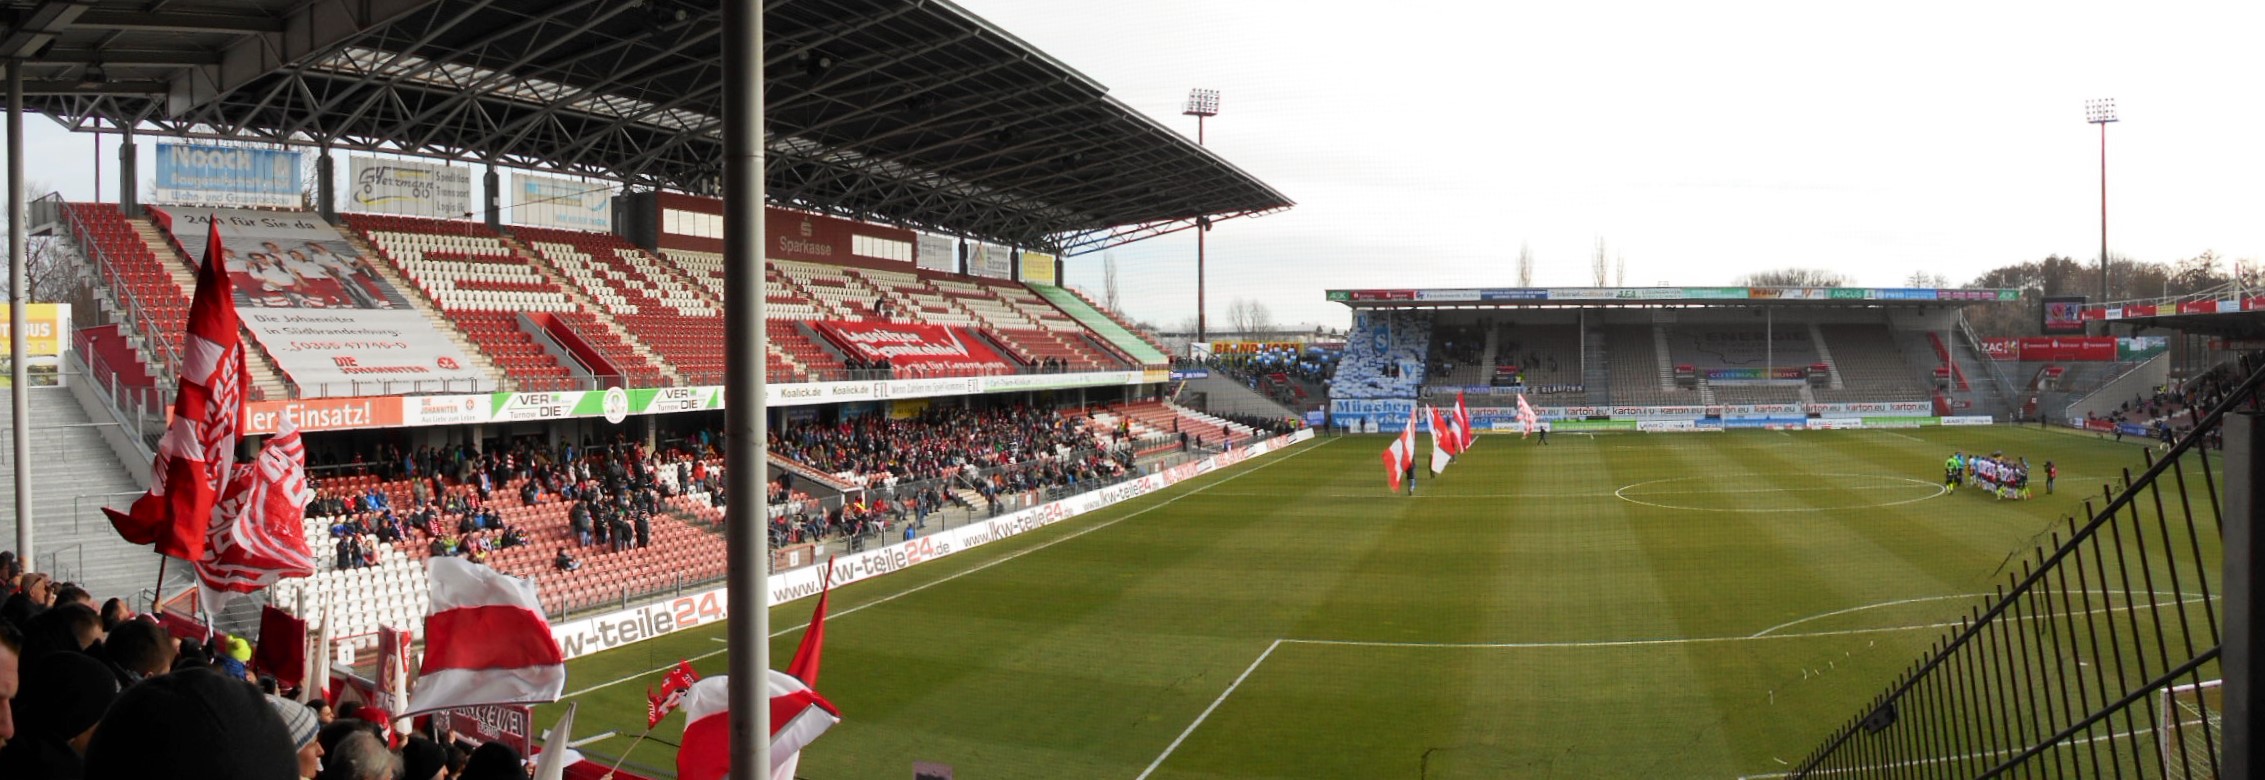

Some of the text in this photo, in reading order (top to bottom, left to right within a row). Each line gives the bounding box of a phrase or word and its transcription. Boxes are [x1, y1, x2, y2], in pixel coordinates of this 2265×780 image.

[230, 216, 256, 227] für
[261, 218, 287, 229] Sie
[295, 220, 317, 230] da
[779, 236, 832, 256] Sparkasse
[254, 314, 356, 324] Die Johanniter
[264, 327, 276, 335] in
[665, 389, 688, 399] VER
[781, 388, 822, 398] Koalick.de
[832, 385, 869, 396] Koalick.de
[519, 394, 549, 405] VER
[681, 400, 698, 409] DIE
[540, 406, 561, 417] DIE
[1845, 403, 1885, 412] karton.eu
[1890, 402, 1930, 411] karton.eu
[286, 401, 371, 428] Einsatz!
[1470, 408, 1512, 416] karton.eu
[963, 502, 1074, 547] www.lkw-teile24.de
